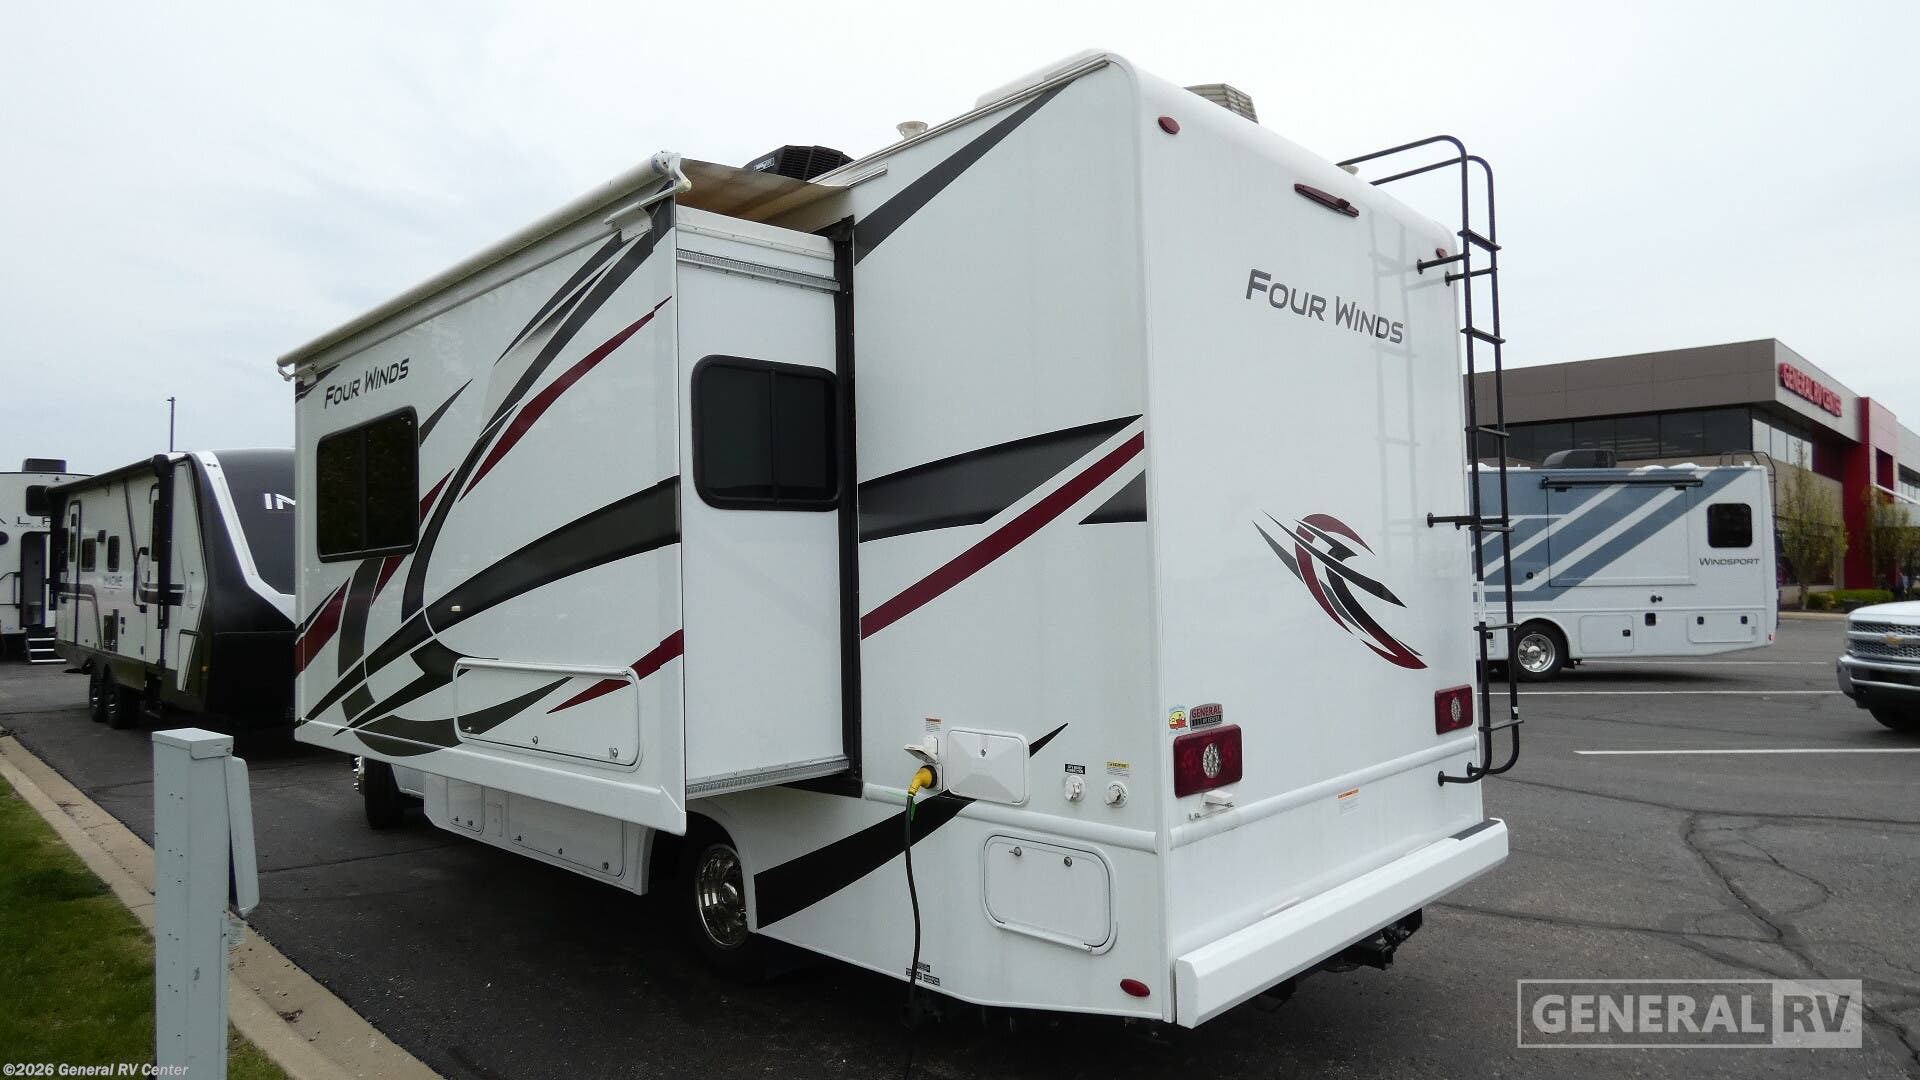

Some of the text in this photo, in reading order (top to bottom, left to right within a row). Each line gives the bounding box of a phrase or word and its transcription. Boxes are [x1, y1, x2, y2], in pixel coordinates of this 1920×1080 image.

[1246, 269, 1404, 344] FOUR WINDS
[324, 357, 410, 409] FOUR WINDS
[1779, 363, 1814, 401] GENERAL
[1699, 557, 1760, 566] WINDSPORT
[1191, 705, 1222, 719] GENERAL
